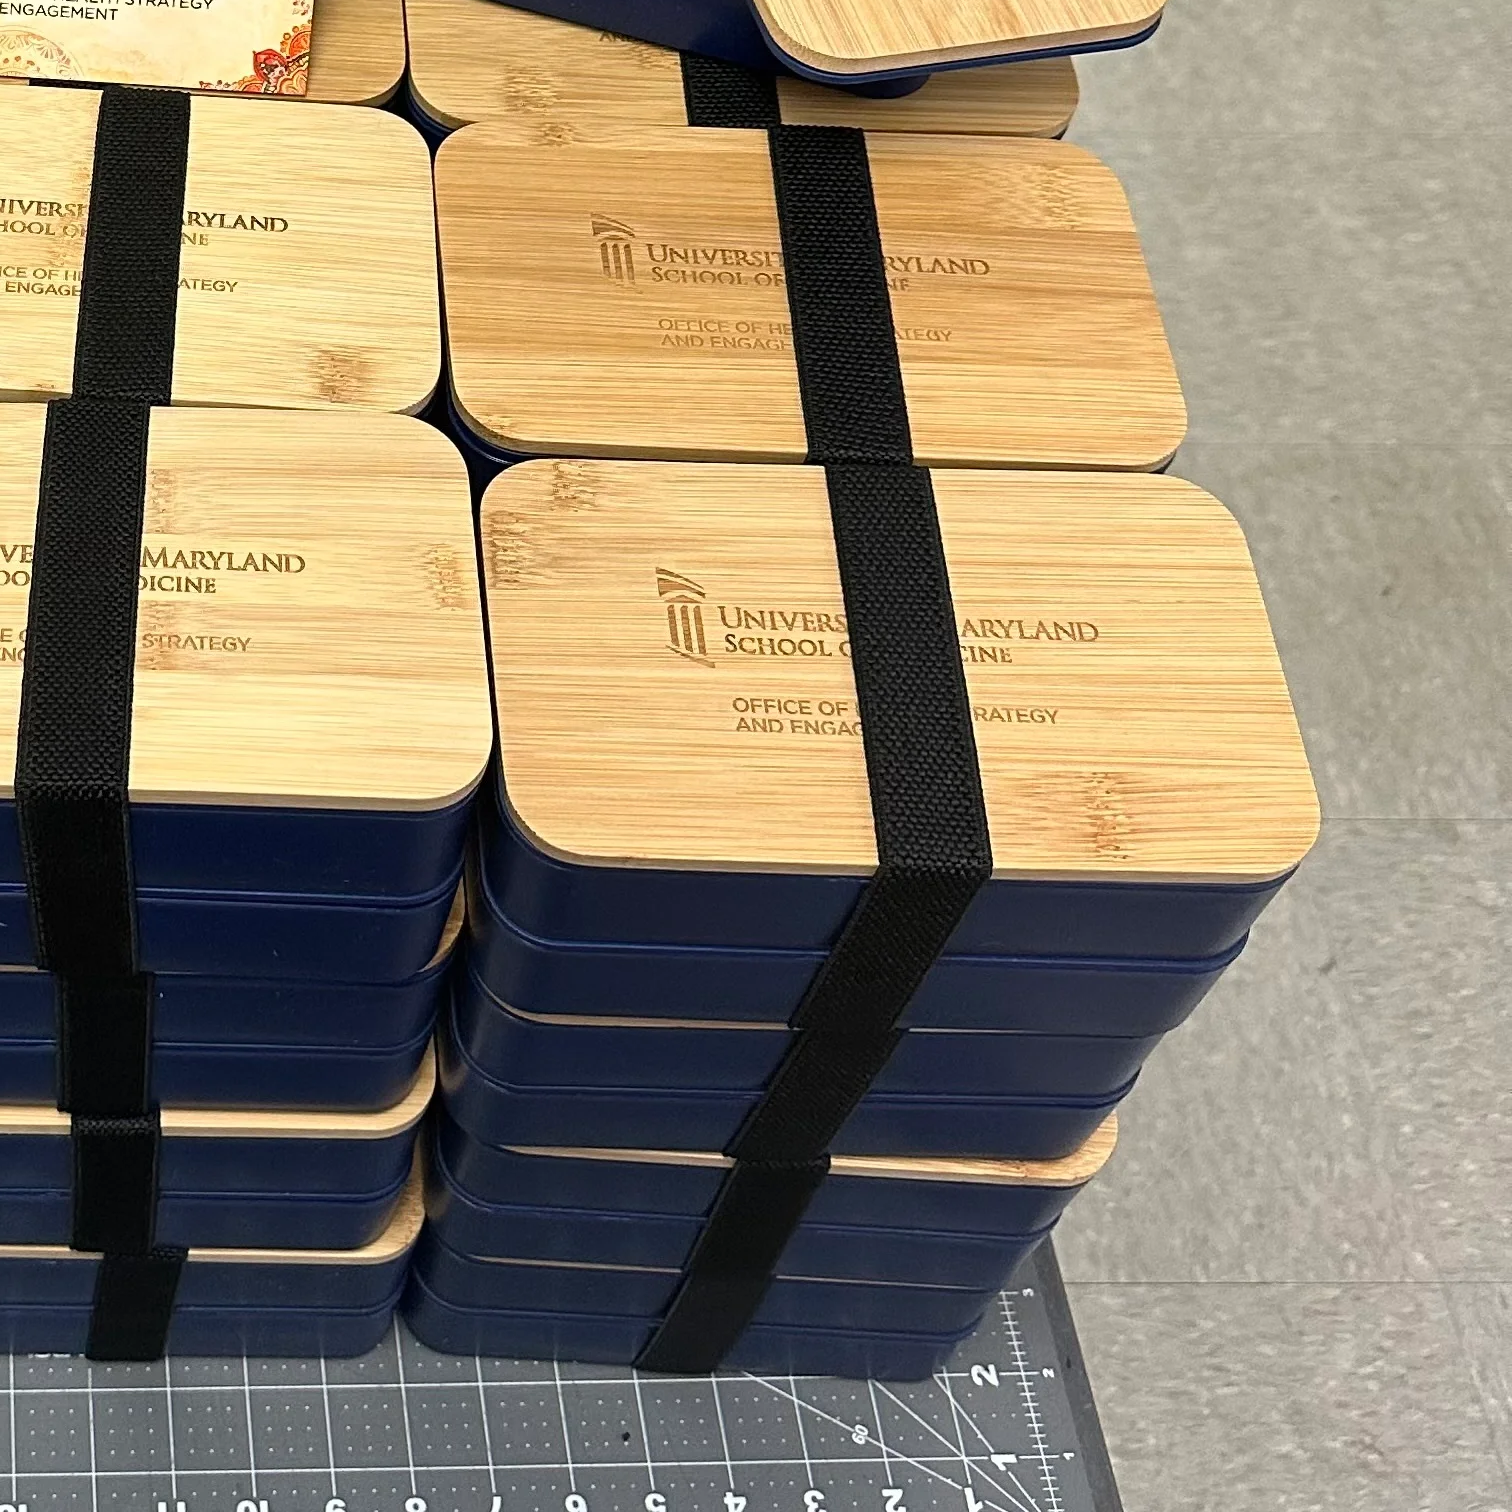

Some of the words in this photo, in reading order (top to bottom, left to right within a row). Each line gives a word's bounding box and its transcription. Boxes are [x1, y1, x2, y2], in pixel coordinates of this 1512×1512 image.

[0, 1, 119, 22] ENGAGEMENT
[183, 210, 289, 233] RYLAND
[651, 266, 748, 286] SCHOOL
[884, 255, 990, 276] RYLAND
[5, 281, 81, 296] ENGAGE
[32, 268, 59, 281] OF
[178, 277, 238, 293] ATEGY
[658, 318, 730, 333] OFFICE
[735, 321, 763, 334] OF
[661, 334, 704, 348] AND
[140, 545, 306, 574] MARYLAND
[717, 605, 846, 634] UNIVERS
[960, 618, 1099, 642] ARYLAND
[142, 632, 252, 653] STRATEGY
[724, 633, 833, 657] SCHOOL
[732, 697, 812, 714] OFFICE
[817, 700, 849, 717] OF
[973, 706, 1059, 725] RATEGY
[736, 717, 784, 733] AND
[789, 719, 862, 736] ENGAG
[970, 1363, 1000, 1388] 2
[1041, 1366, 1056, 1379] 2
[990, 1452, 1018, 1472] 1
